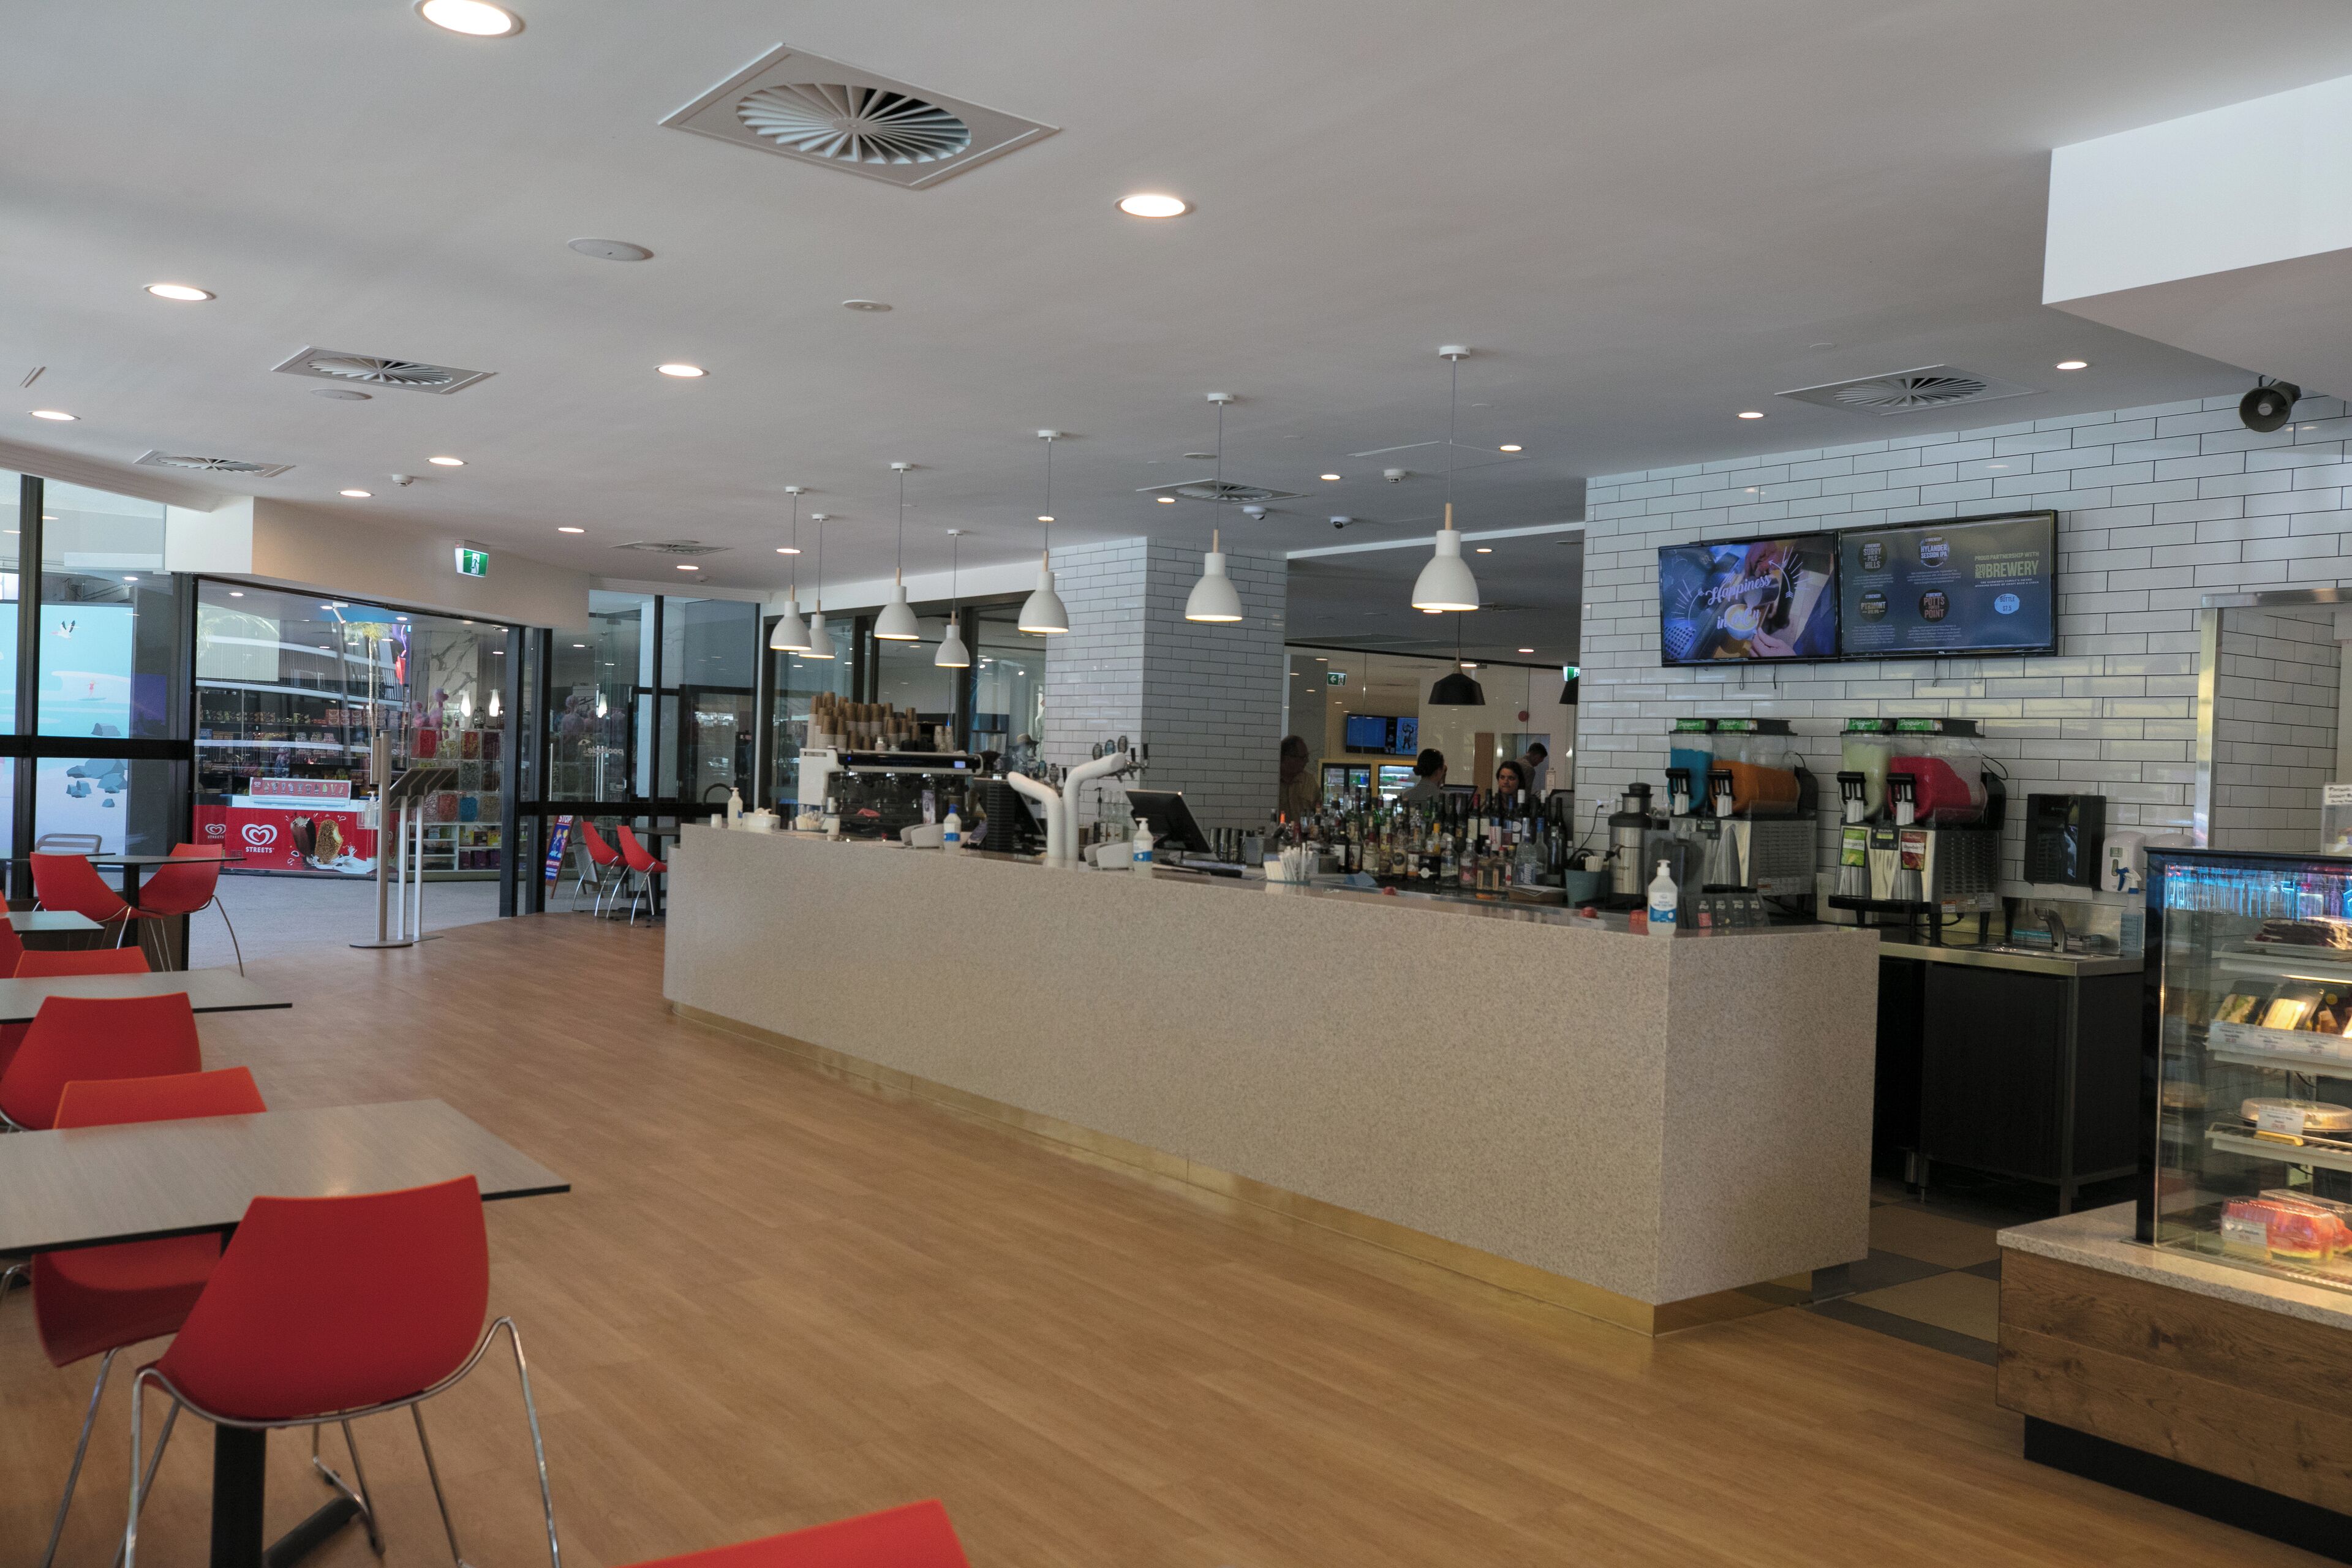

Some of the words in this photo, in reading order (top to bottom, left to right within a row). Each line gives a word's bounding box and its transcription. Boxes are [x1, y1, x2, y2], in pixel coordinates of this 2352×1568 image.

[1863, 547, 1882, 556] SURRY
[1921, 544, 1948, 552] HYLANDER
[1986, 560, 2039, 578] BREWERY
[1705, 575, 1772, 605] Happiness
[1861, 601, 1886, 609] PYRMONT
[1923, 596, 1945, 606] POTTS
[1924, 609, 1945, 619] POINT
